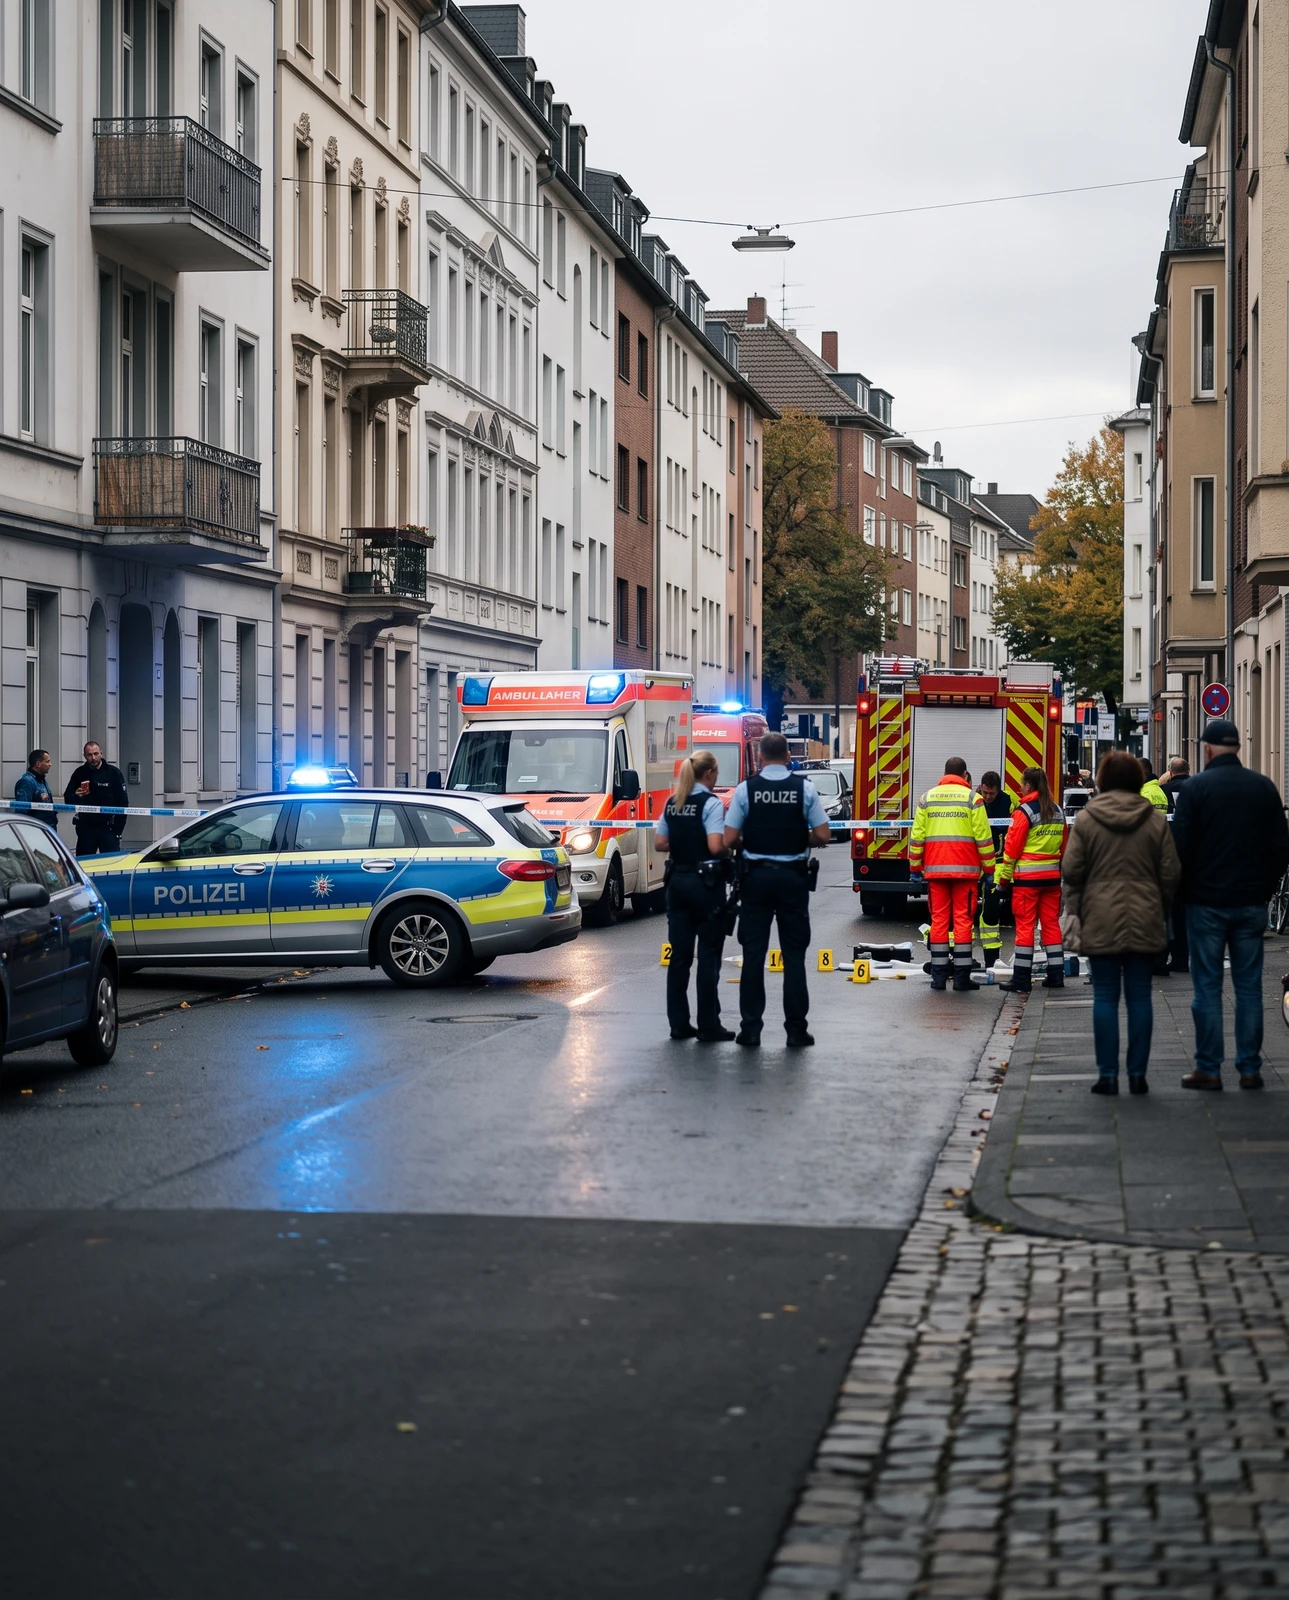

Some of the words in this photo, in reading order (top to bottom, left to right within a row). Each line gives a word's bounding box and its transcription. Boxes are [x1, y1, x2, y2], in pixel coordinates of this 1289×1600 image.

[754, 791, 798, 804] POLIZE
[154, 882, 245, 906] POLIZEI
[664, 947, 672, 960] 2
[822, 952, 830, 966] 8
[857, 964, 865, 978] 6
